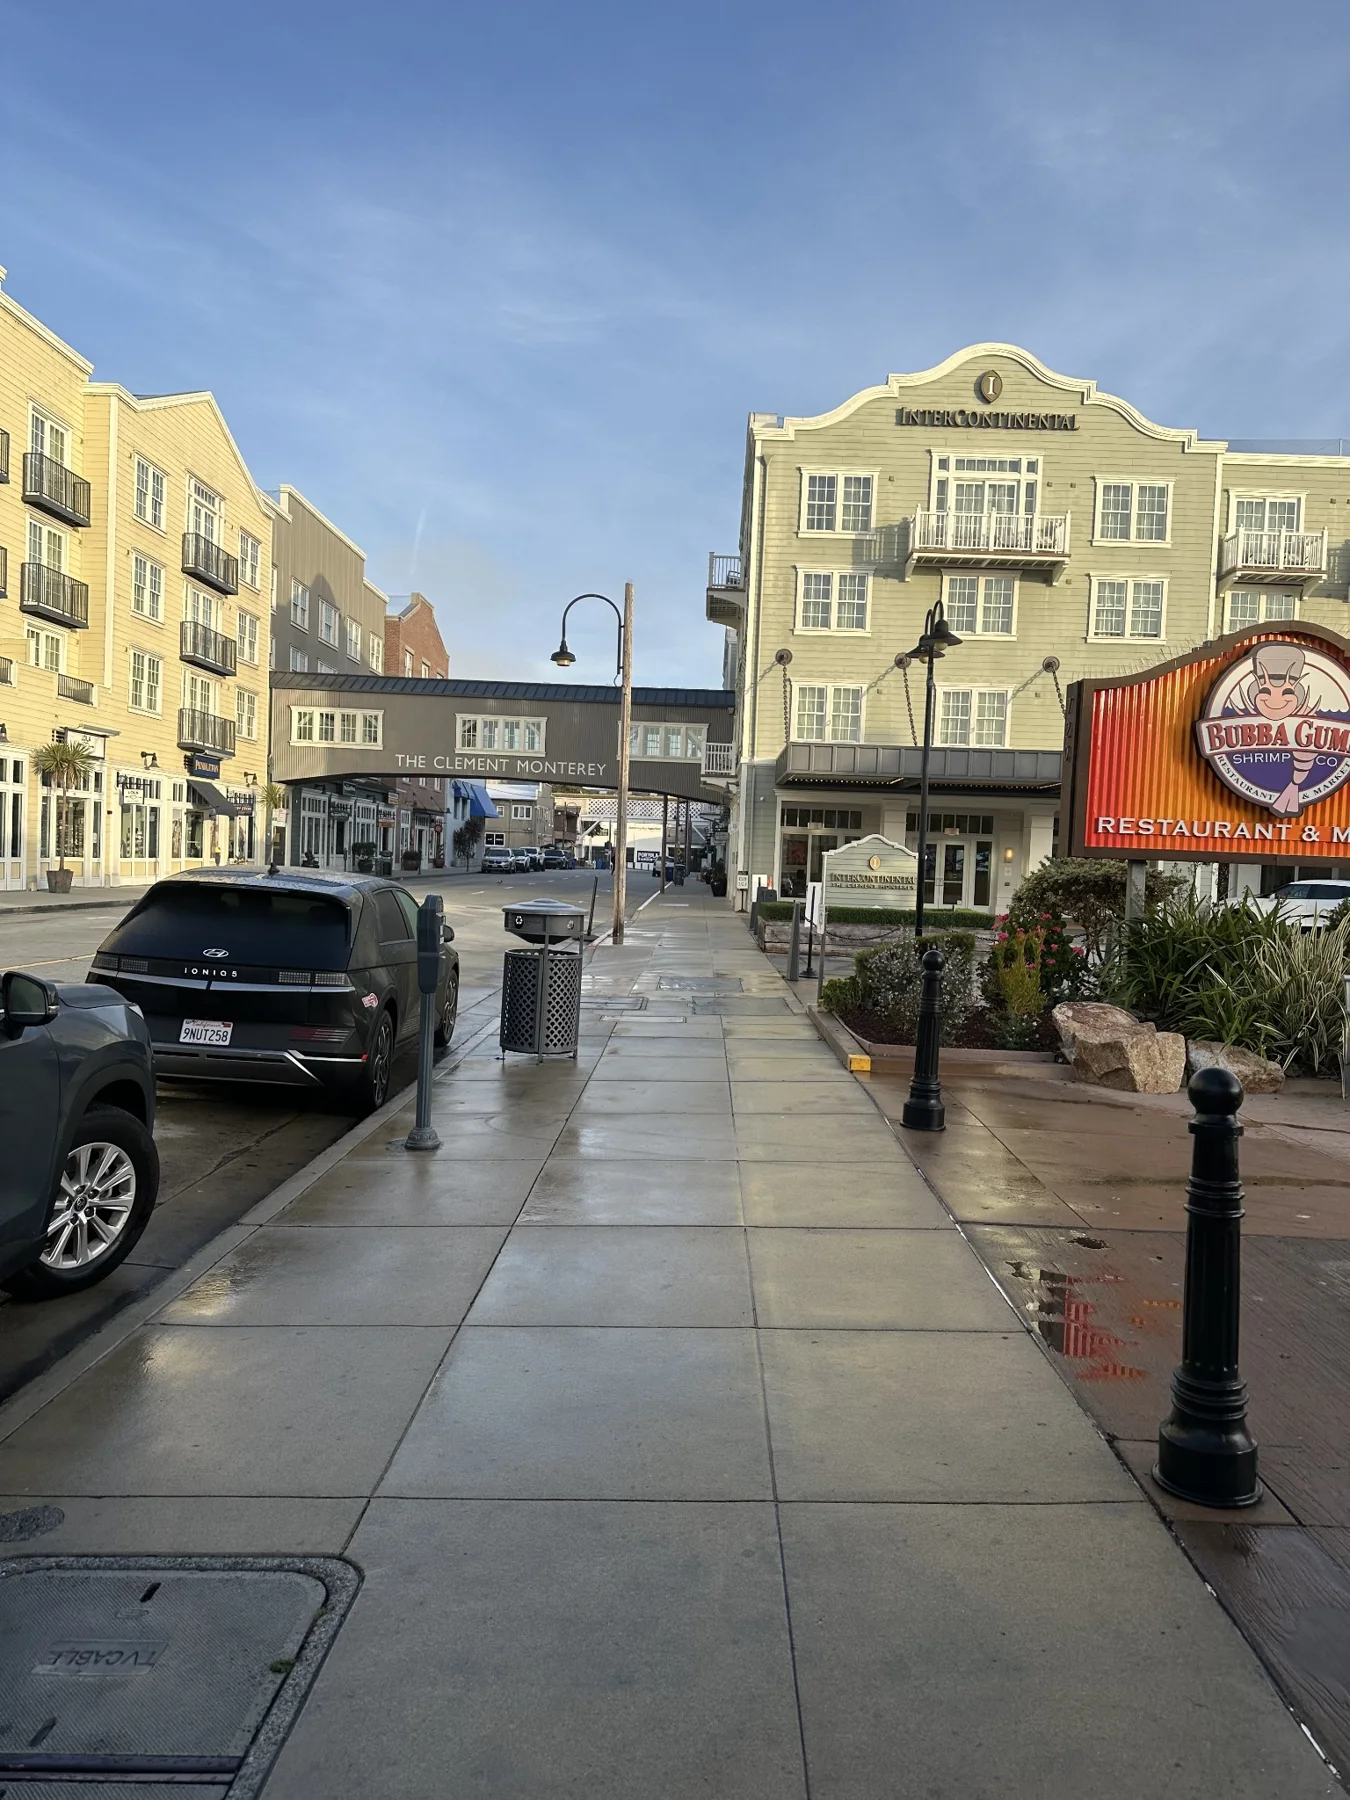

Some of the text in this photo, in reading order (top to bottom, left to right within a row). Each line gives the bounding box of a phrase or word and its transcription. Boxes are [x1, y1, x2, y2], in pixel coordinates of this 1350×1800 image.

[1206, 720, 1350, 753] BUBBA GUM
[395, 754, 607, 776] THE CLEMENT MONTEREY
[1232, 753, 1291, 764] SHRIMP
[1217, 755, 1275, 801] RESTAURANT
[1313, 761, 1350, 796] MARKET
[1097, 816, 1293, 841] RESTAURANT
[1301, 825, 1320, 842] &
[183, 1028, 228, 1042] 9NUT258
